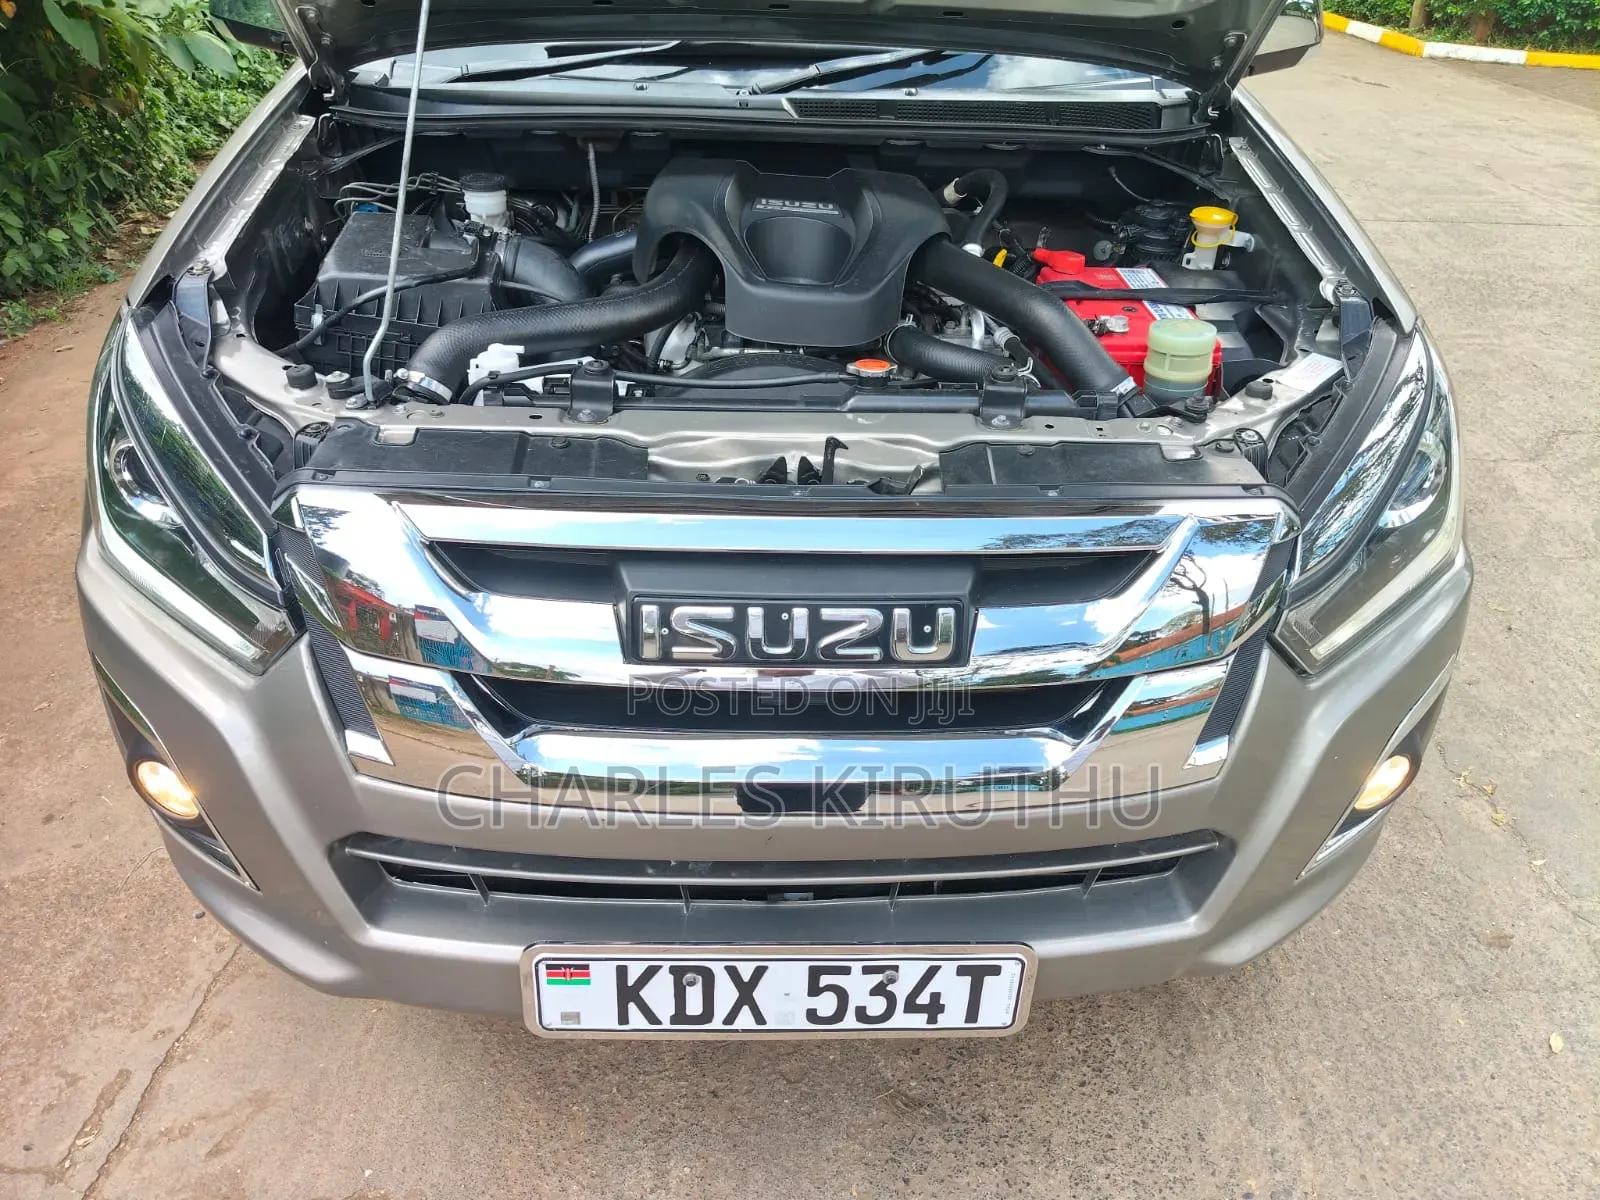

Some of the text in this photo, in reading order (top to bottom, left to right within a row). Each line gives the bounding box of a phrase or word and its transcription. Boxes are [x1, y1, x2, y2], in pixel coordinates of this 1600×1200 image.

[761, 199, 834, 209] ISUZU
[640, 604, 956, 662] ISUZU
[615, 964, 768, 1025] KDX
[805, 964, 1003, 1025] 534T
